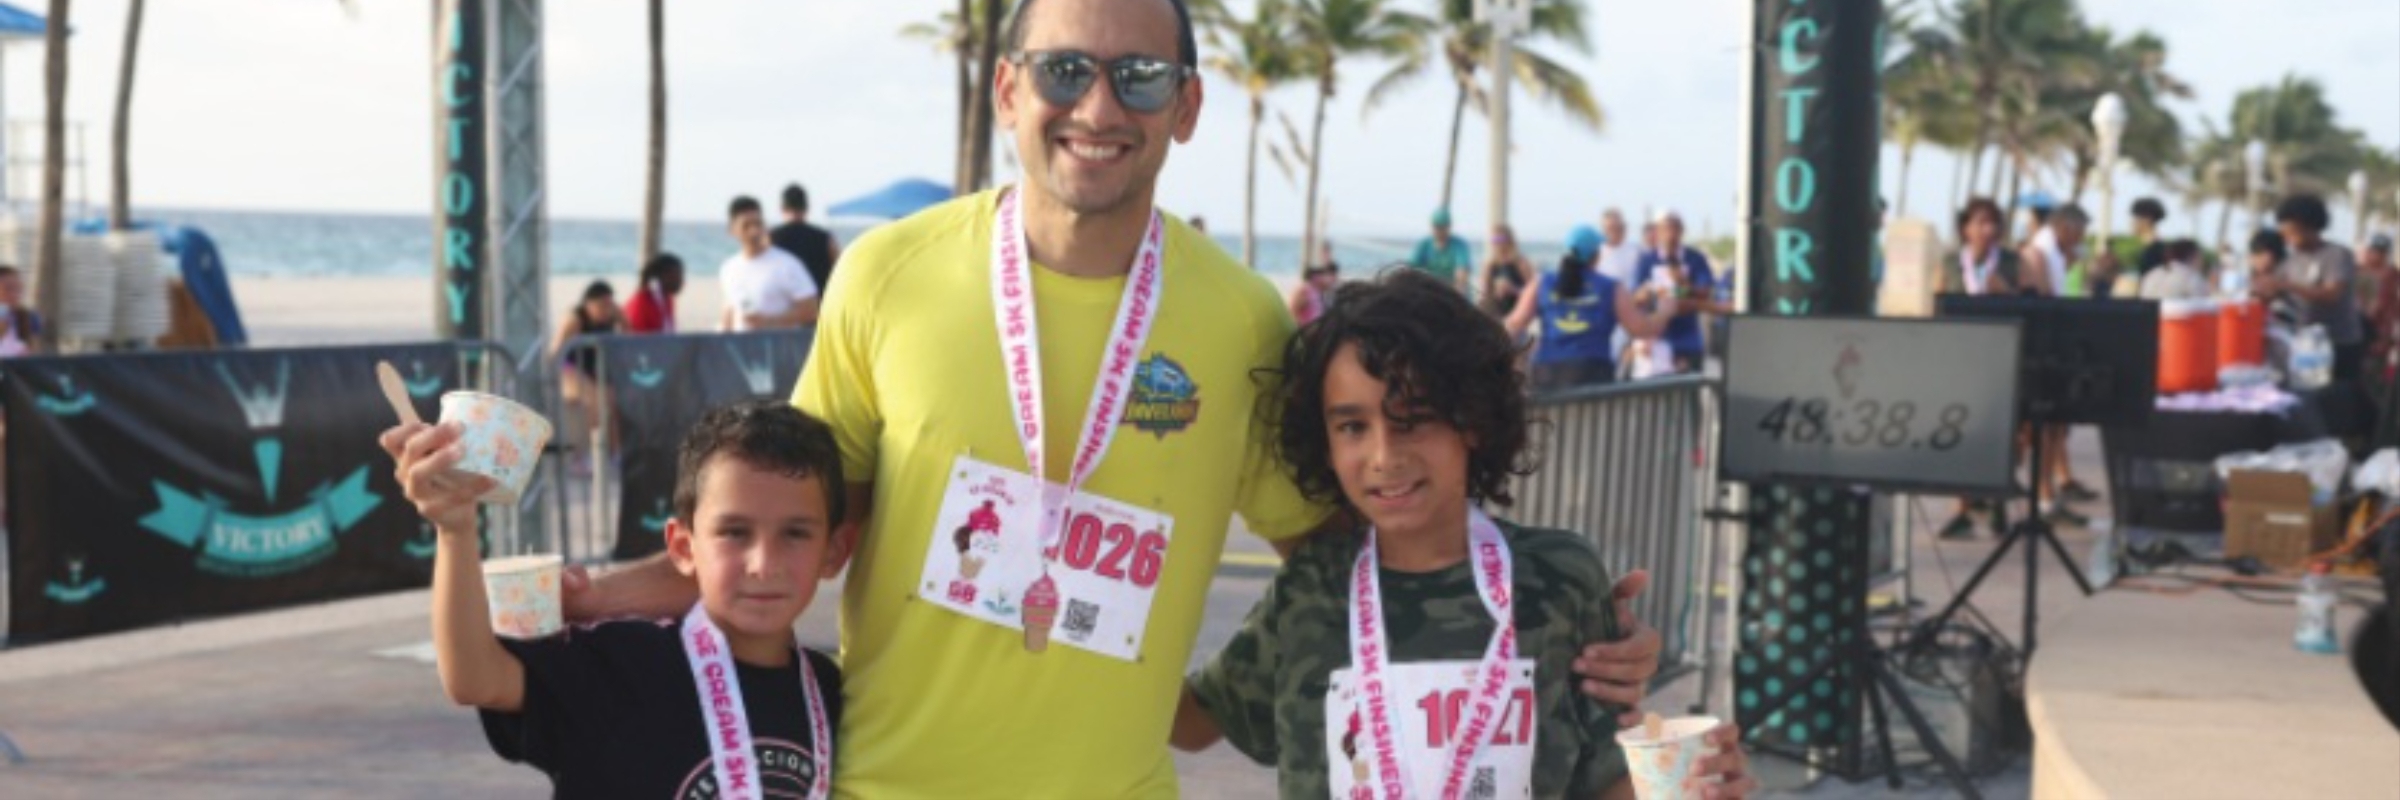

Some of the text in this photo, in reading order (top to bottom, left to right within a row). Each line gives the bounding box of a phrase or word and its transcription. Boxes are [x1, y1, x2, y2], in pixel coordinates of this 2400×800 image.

[1775, 0, 1820, 314] CTOR
[1758, 397, 1969, 450] 48:38.8
[213, 515, 325, 555] VICTORY
[703, 660, 741, 750] CREAM
